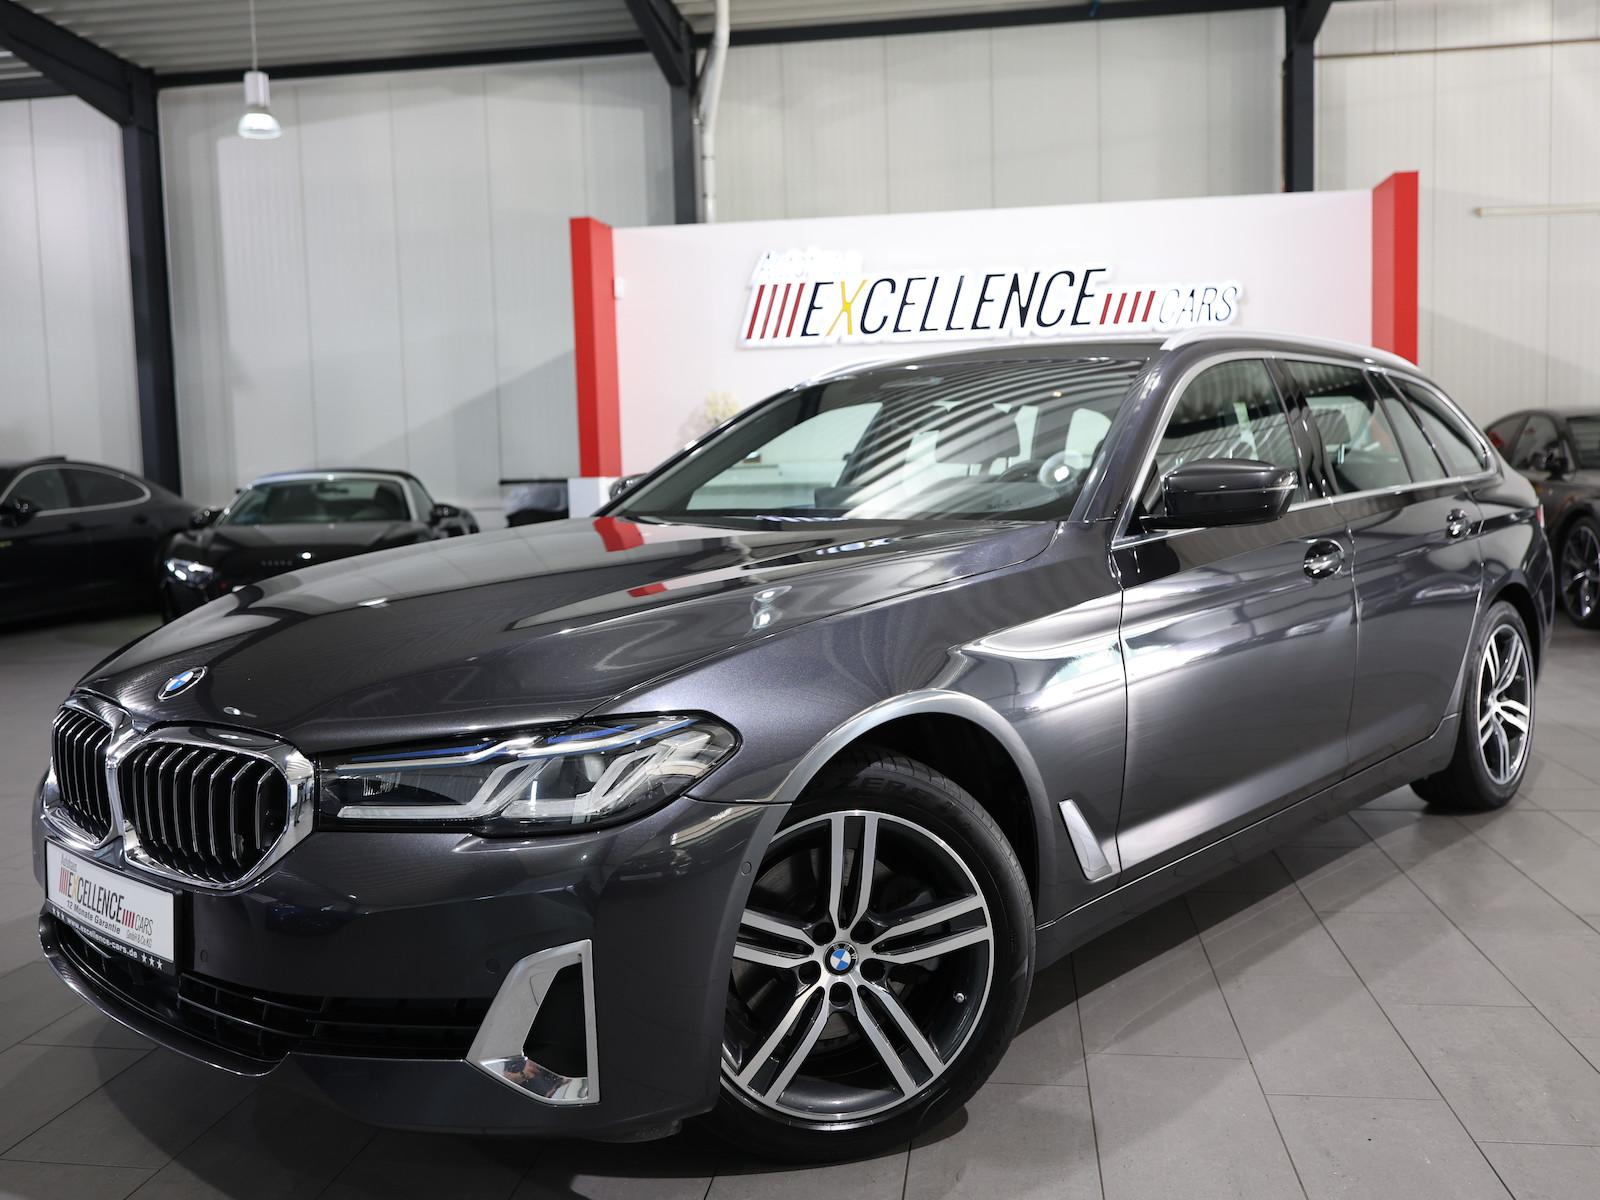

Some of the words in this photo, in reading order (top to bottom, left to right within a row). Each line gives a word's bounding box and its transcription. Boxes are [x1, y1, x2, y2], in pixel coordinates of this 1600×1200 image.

[801, 268, 1107, 336] EXCELLENCE
[1159, 286, 1238, 323] CARS
[68, 872, 124, 923] EXCELLENCE
[135, 914, 154, 936] CARS
[74, 904, 93, 921] Monate
[95, 915, 121, 934] Garantie
